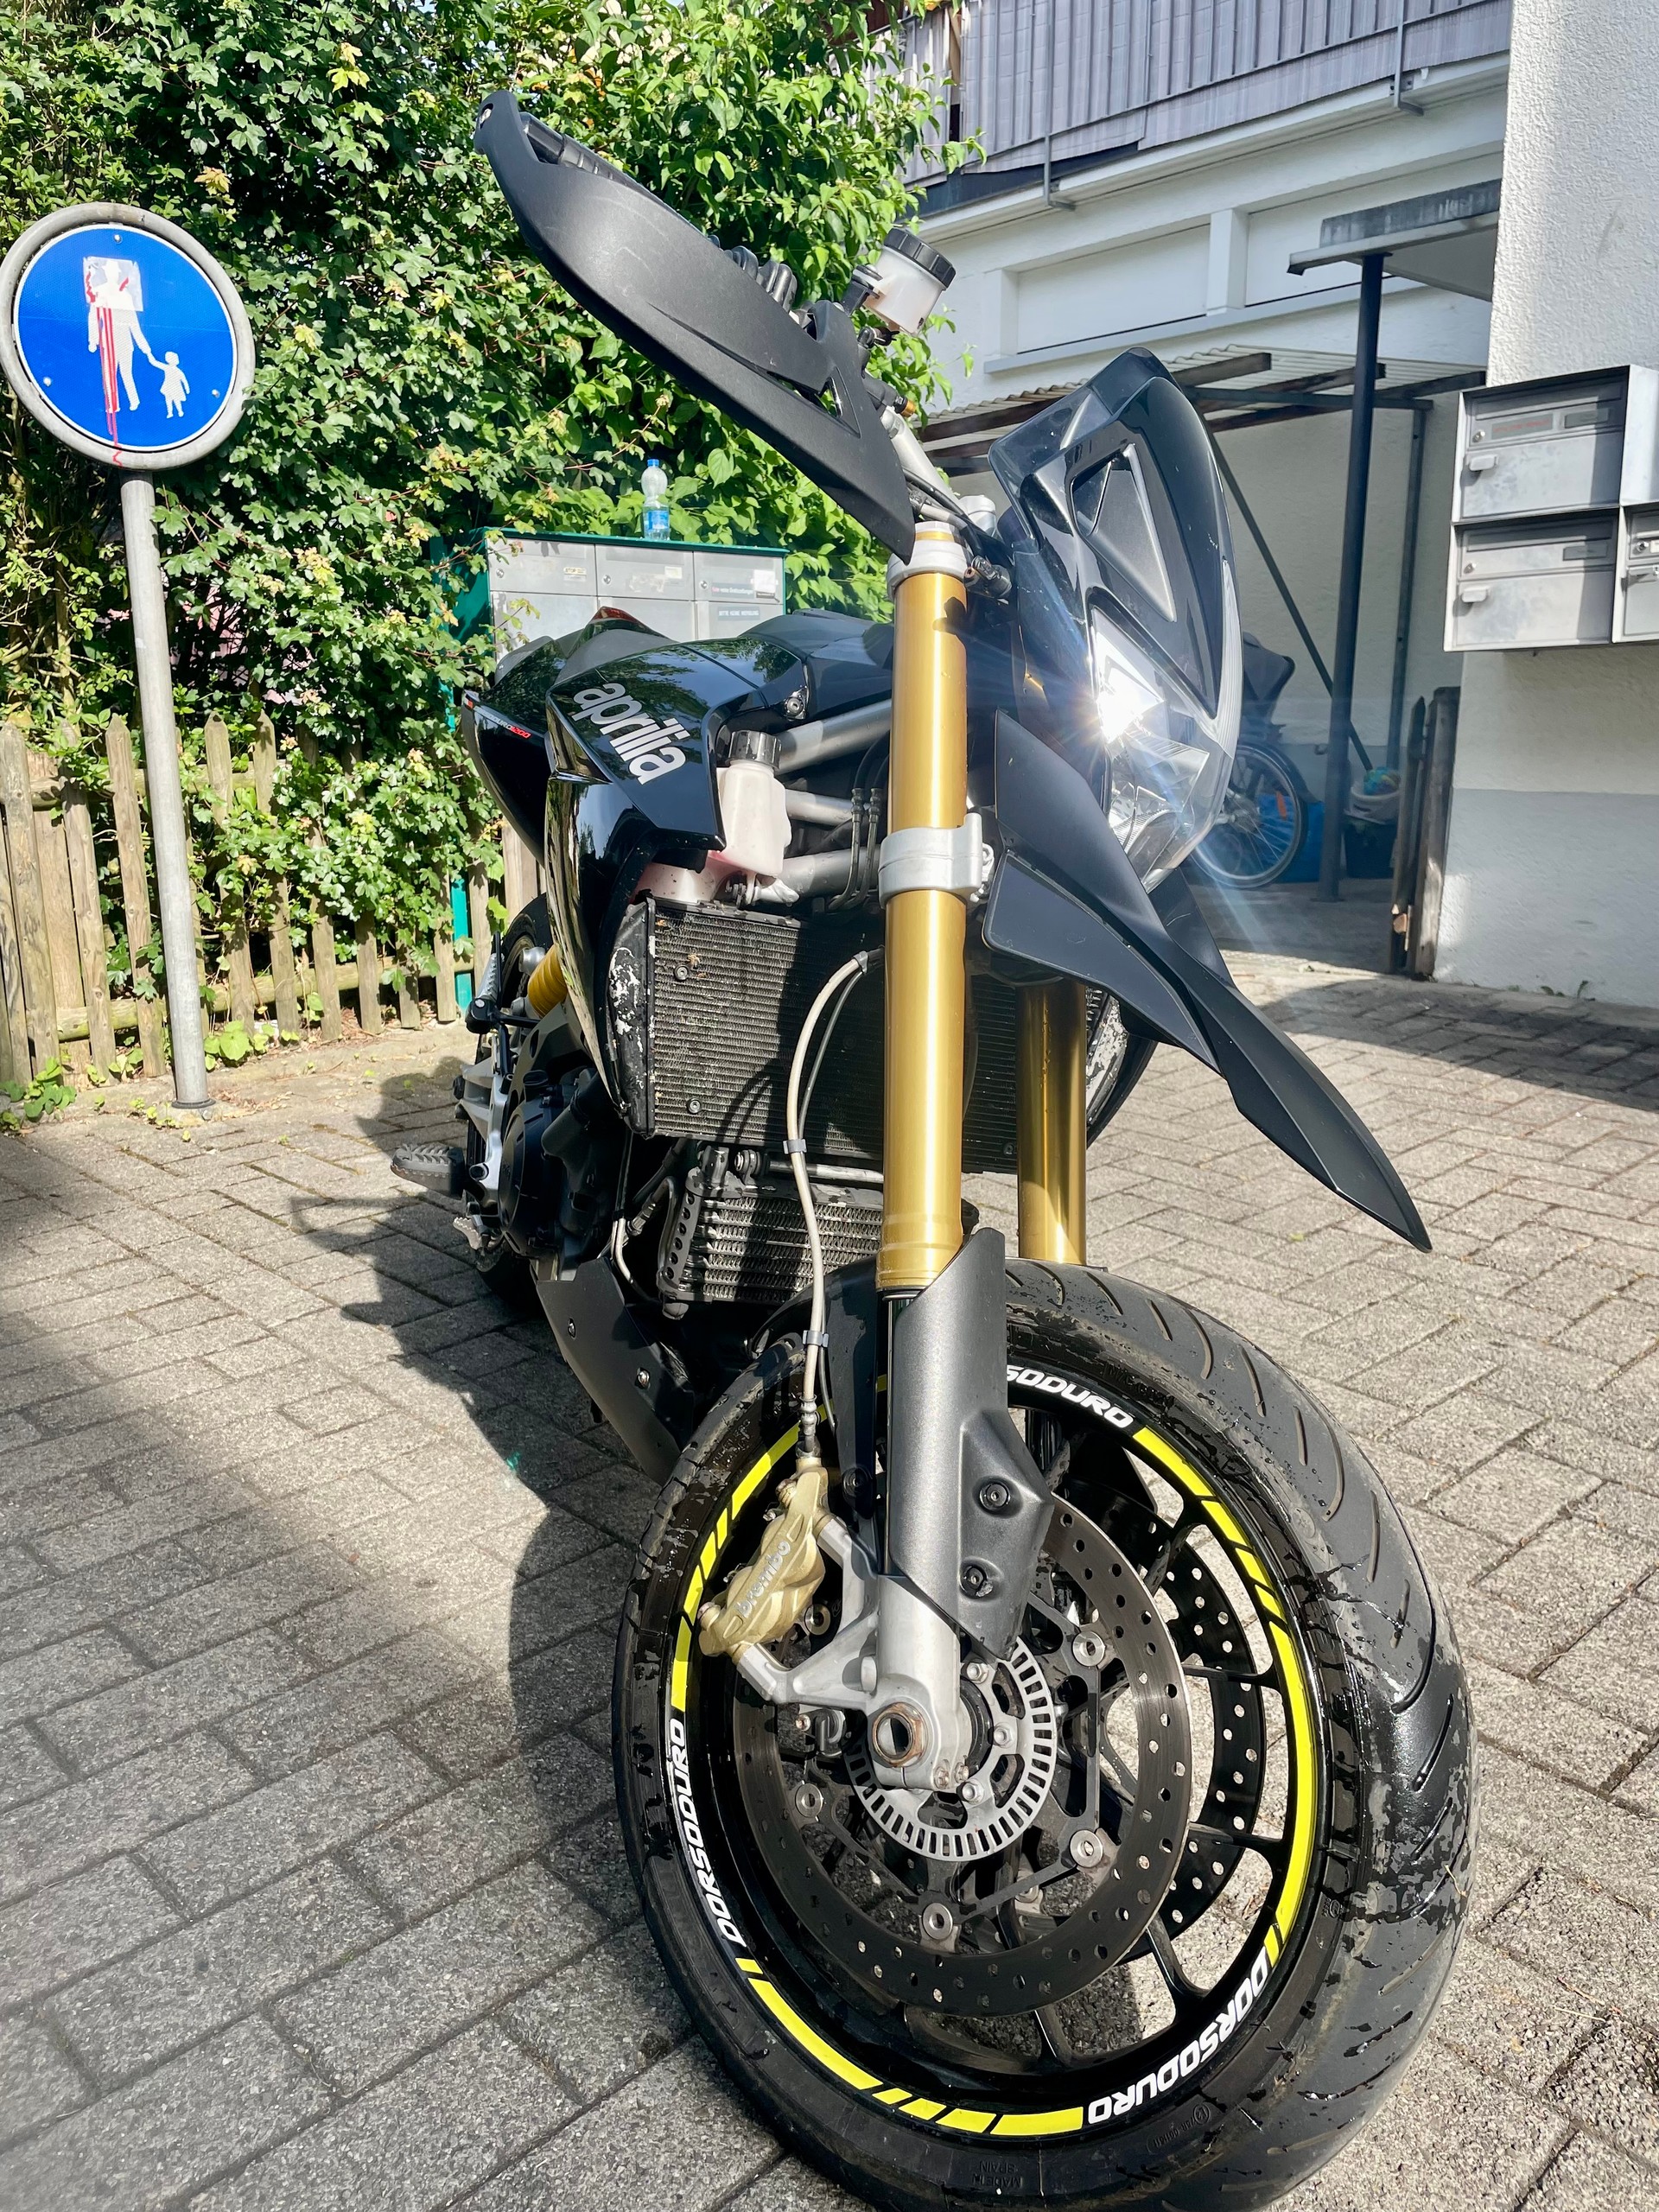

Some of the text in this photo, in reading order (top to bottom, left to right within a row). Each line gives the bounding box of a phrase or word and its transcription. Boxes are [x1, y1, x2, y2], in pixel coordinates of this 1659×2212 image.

[571, 682, 690, 785] aprilia
[736, 1539, 791, 1618] brembo
[670, 1717, 747, 1948] DORSODURO
[1088, 1947, 1268, 2125] DORSODURO
